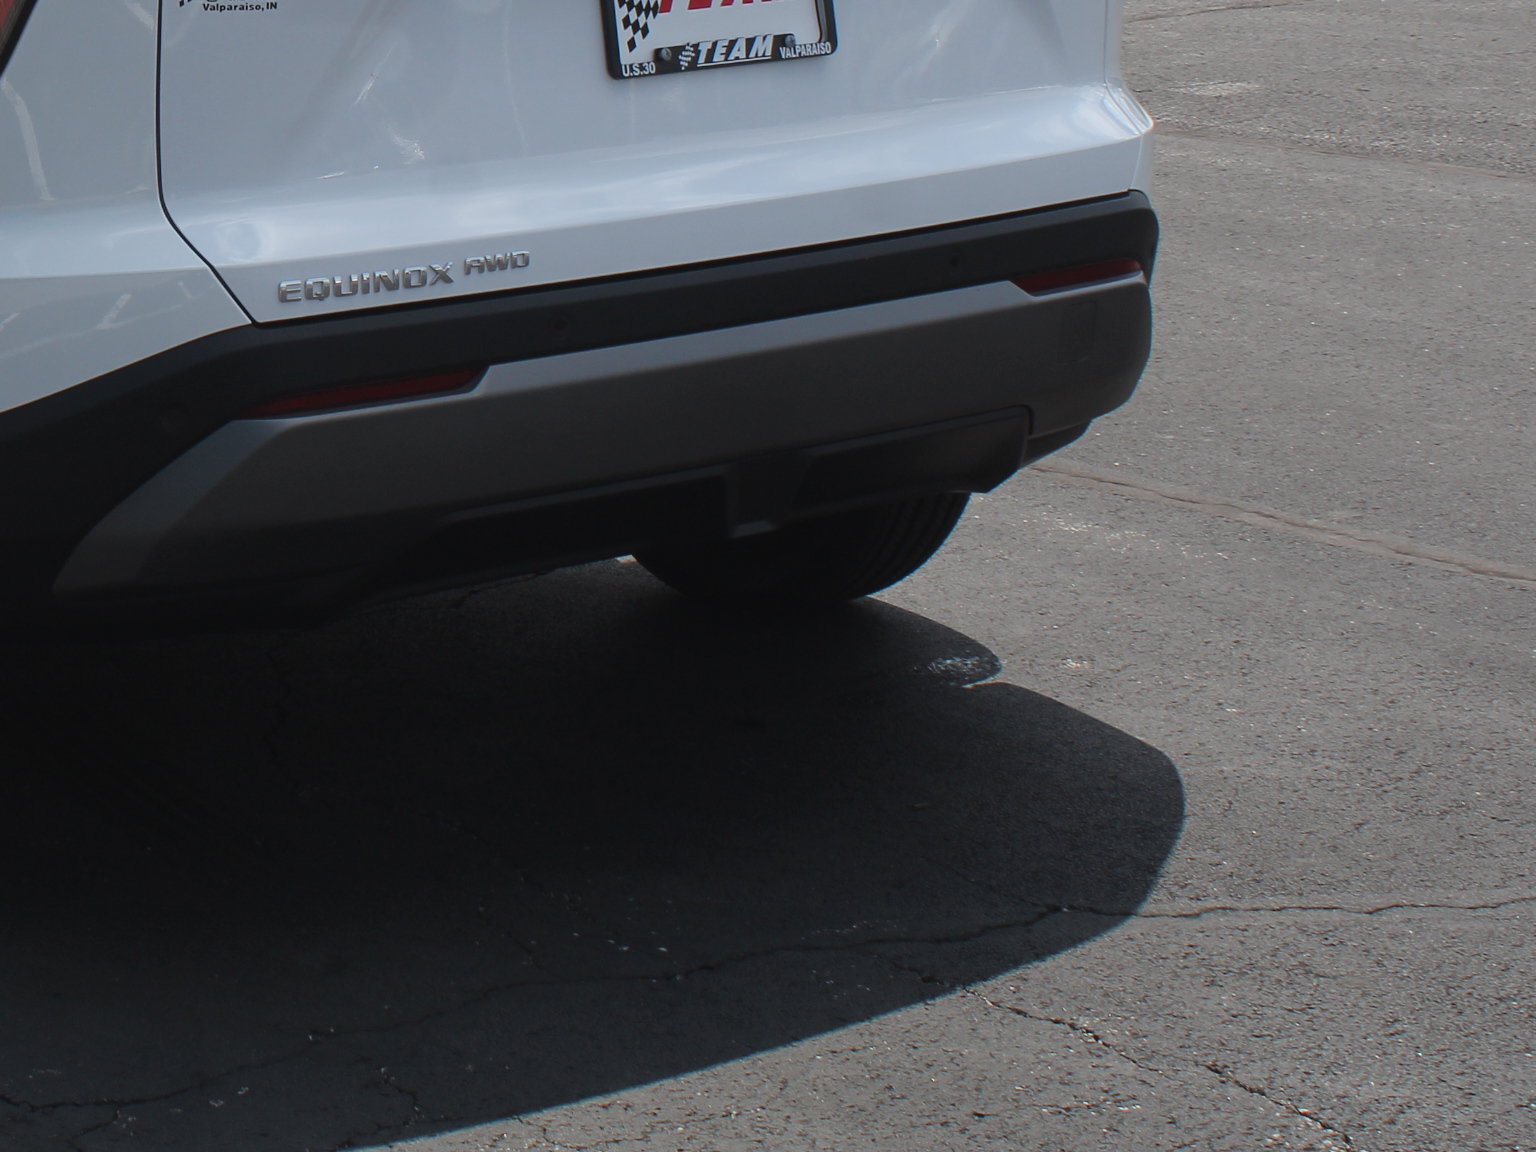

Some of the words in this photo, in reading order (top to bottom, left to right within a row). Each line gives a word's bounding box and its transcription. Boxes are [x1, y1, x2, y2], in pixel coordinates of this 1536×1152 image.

[203, 3, 265, 12] Valparaiso,
[266, 2, 277, 10] IN
[697, 33, 773, 63] TEAM
[779, 41, 831, 59] VALPARAISO
[278, 261, 453, 303] EQUINOX
[463, 250, 530, 276] AWD
